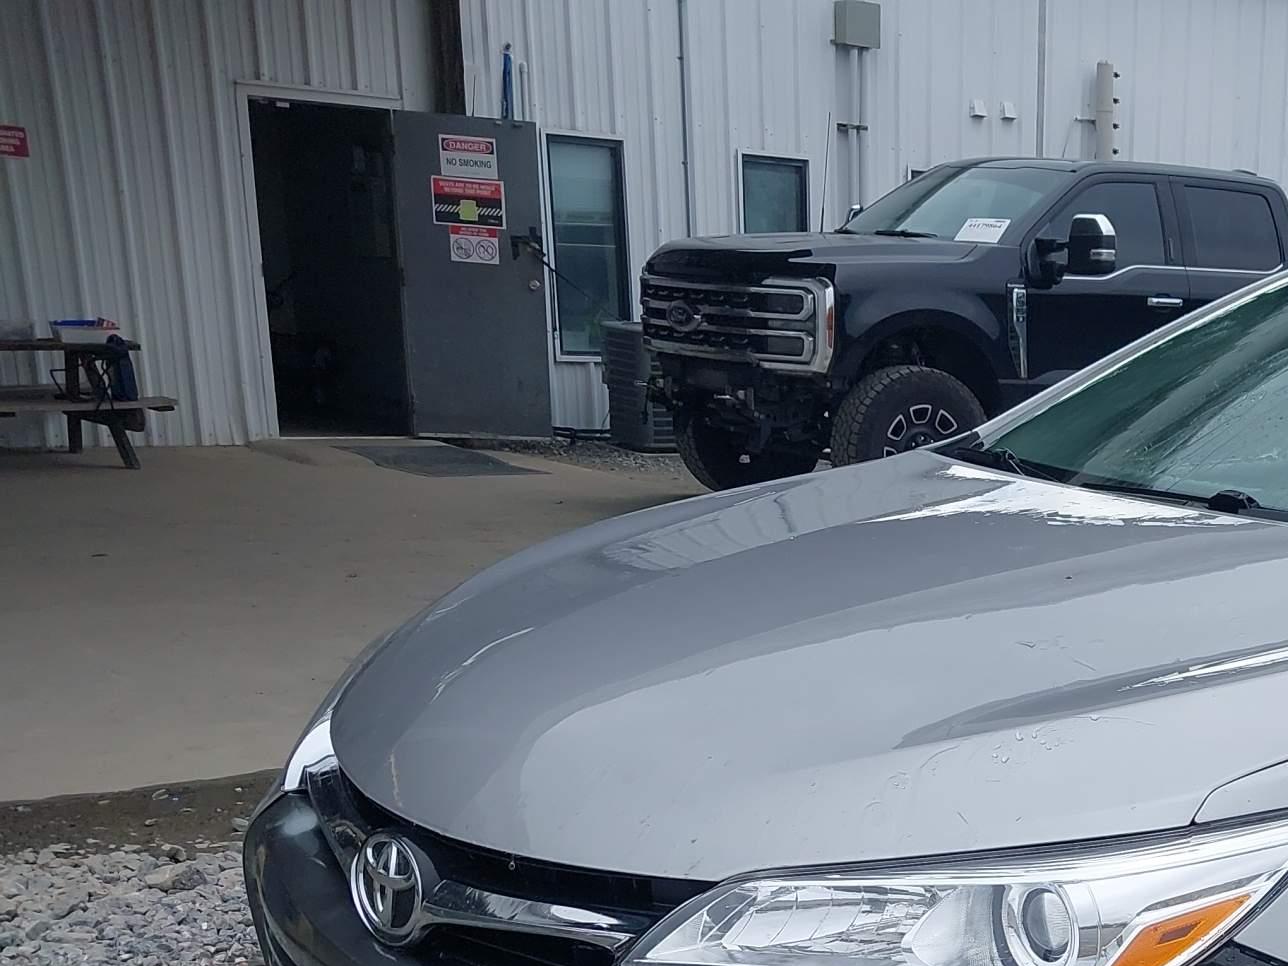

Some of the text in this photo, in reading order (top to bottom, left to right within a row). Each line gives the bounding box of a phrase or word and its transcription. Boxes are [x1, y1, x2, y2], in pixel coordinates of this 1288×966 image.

[449, 141, 487, 152] DANGER
[446, 158, 492, 169] NO SMOKING
